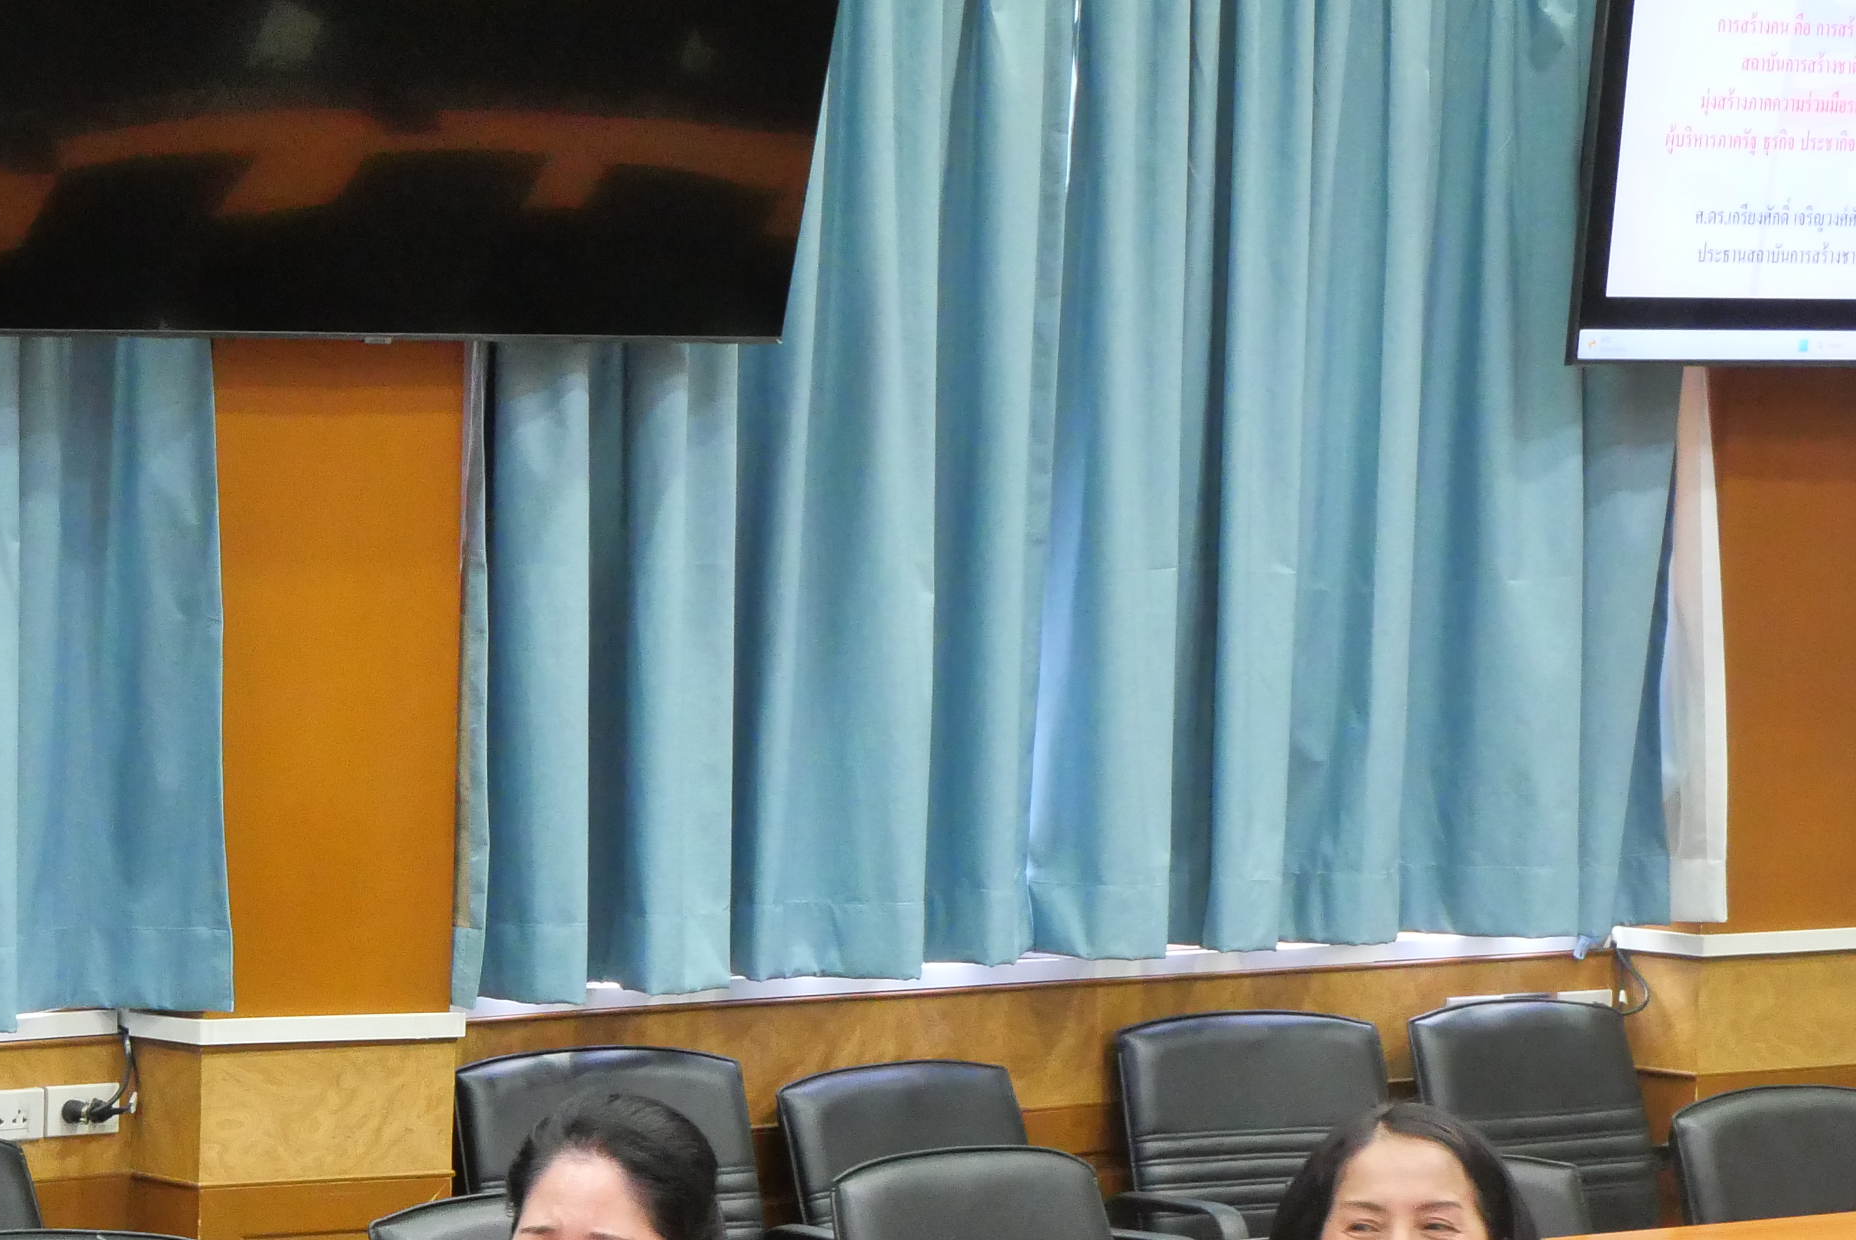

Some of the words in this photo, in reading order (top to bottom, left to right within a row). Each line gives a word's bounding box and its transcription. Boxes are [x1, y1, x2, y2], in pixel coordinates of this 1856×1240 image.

[1718, 11, 1789, 35] การสร้างคน
[1794, 12, 1811, 36] คือ
[1700, 87, 1856, 116] มุ่งสร้างภาคความร่วมมือร
[1665, 123, 1757, 155] ผู้บริหารภาครัฐ
[1763, 128, 1795, 155] ธุรกิจ
